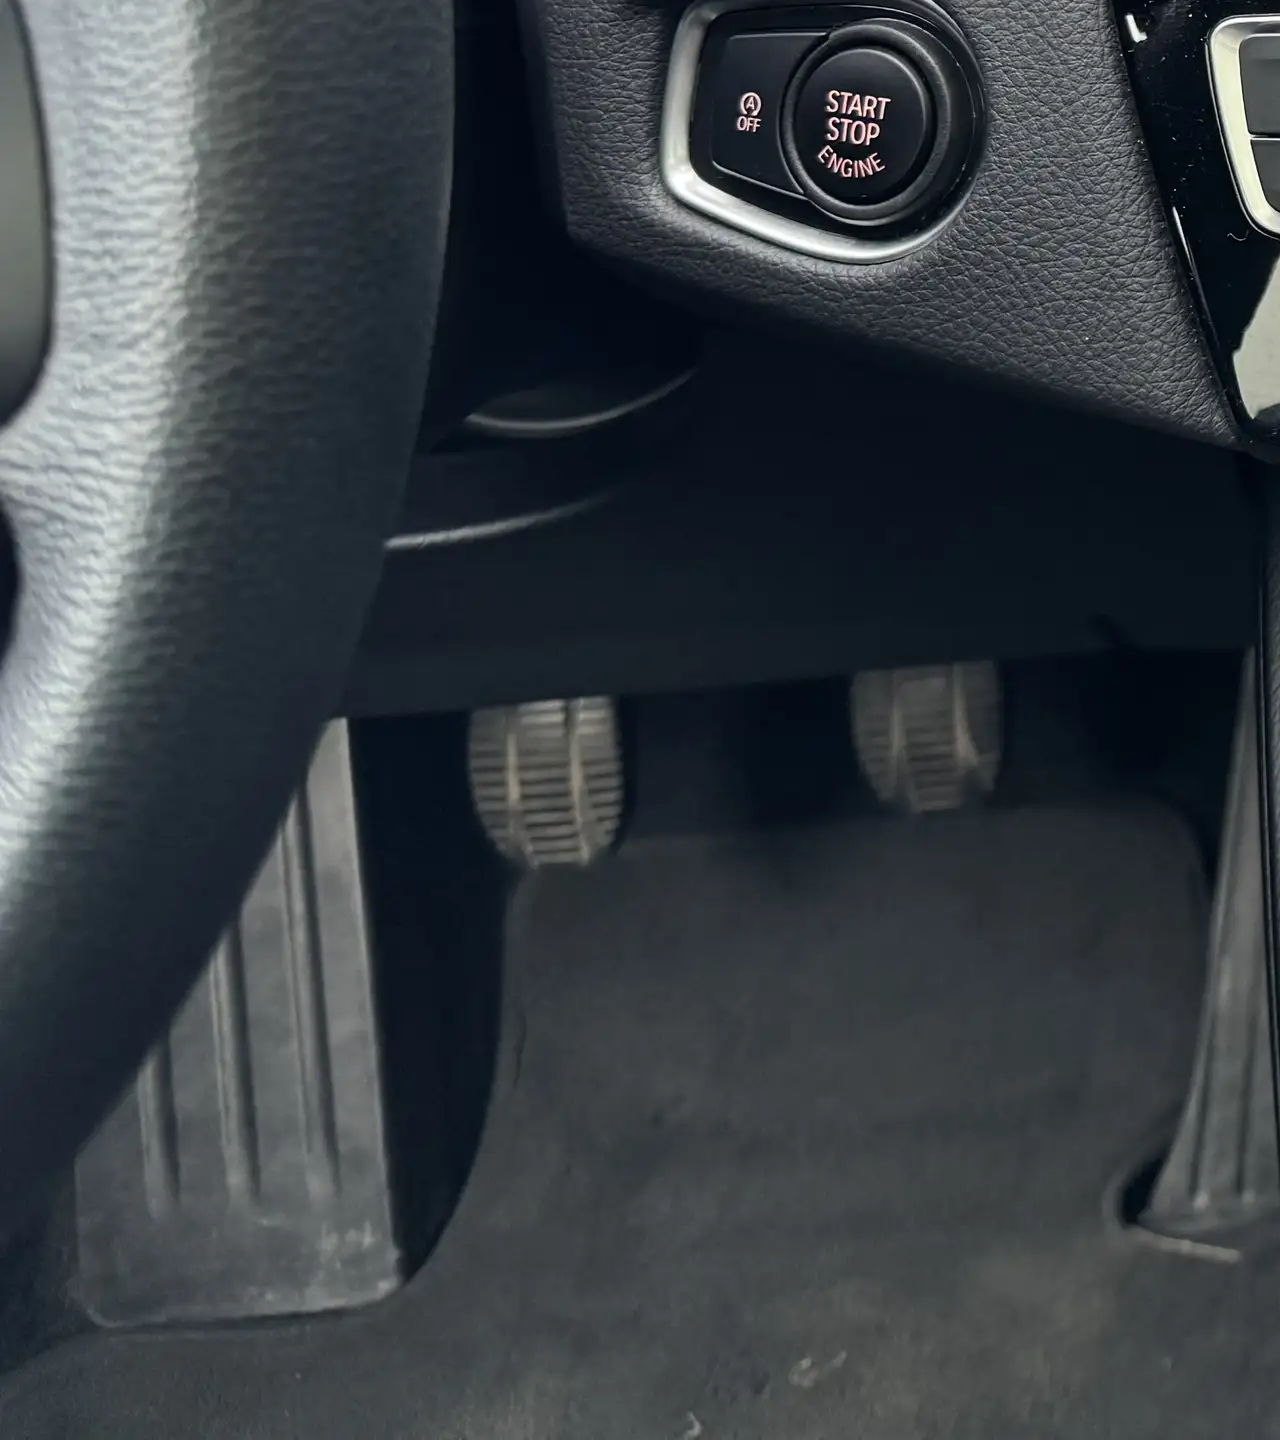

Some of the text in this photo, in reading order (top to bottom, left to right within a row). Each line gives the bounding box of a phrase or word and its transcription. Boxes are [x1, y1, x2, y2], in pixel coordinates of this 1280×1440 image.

[825, 90, 891, 120] START
[736, 116, 762, 133] OFF
[826, 117, 881, 146] STOP
[817, 145, 886, 178] ENGINE
